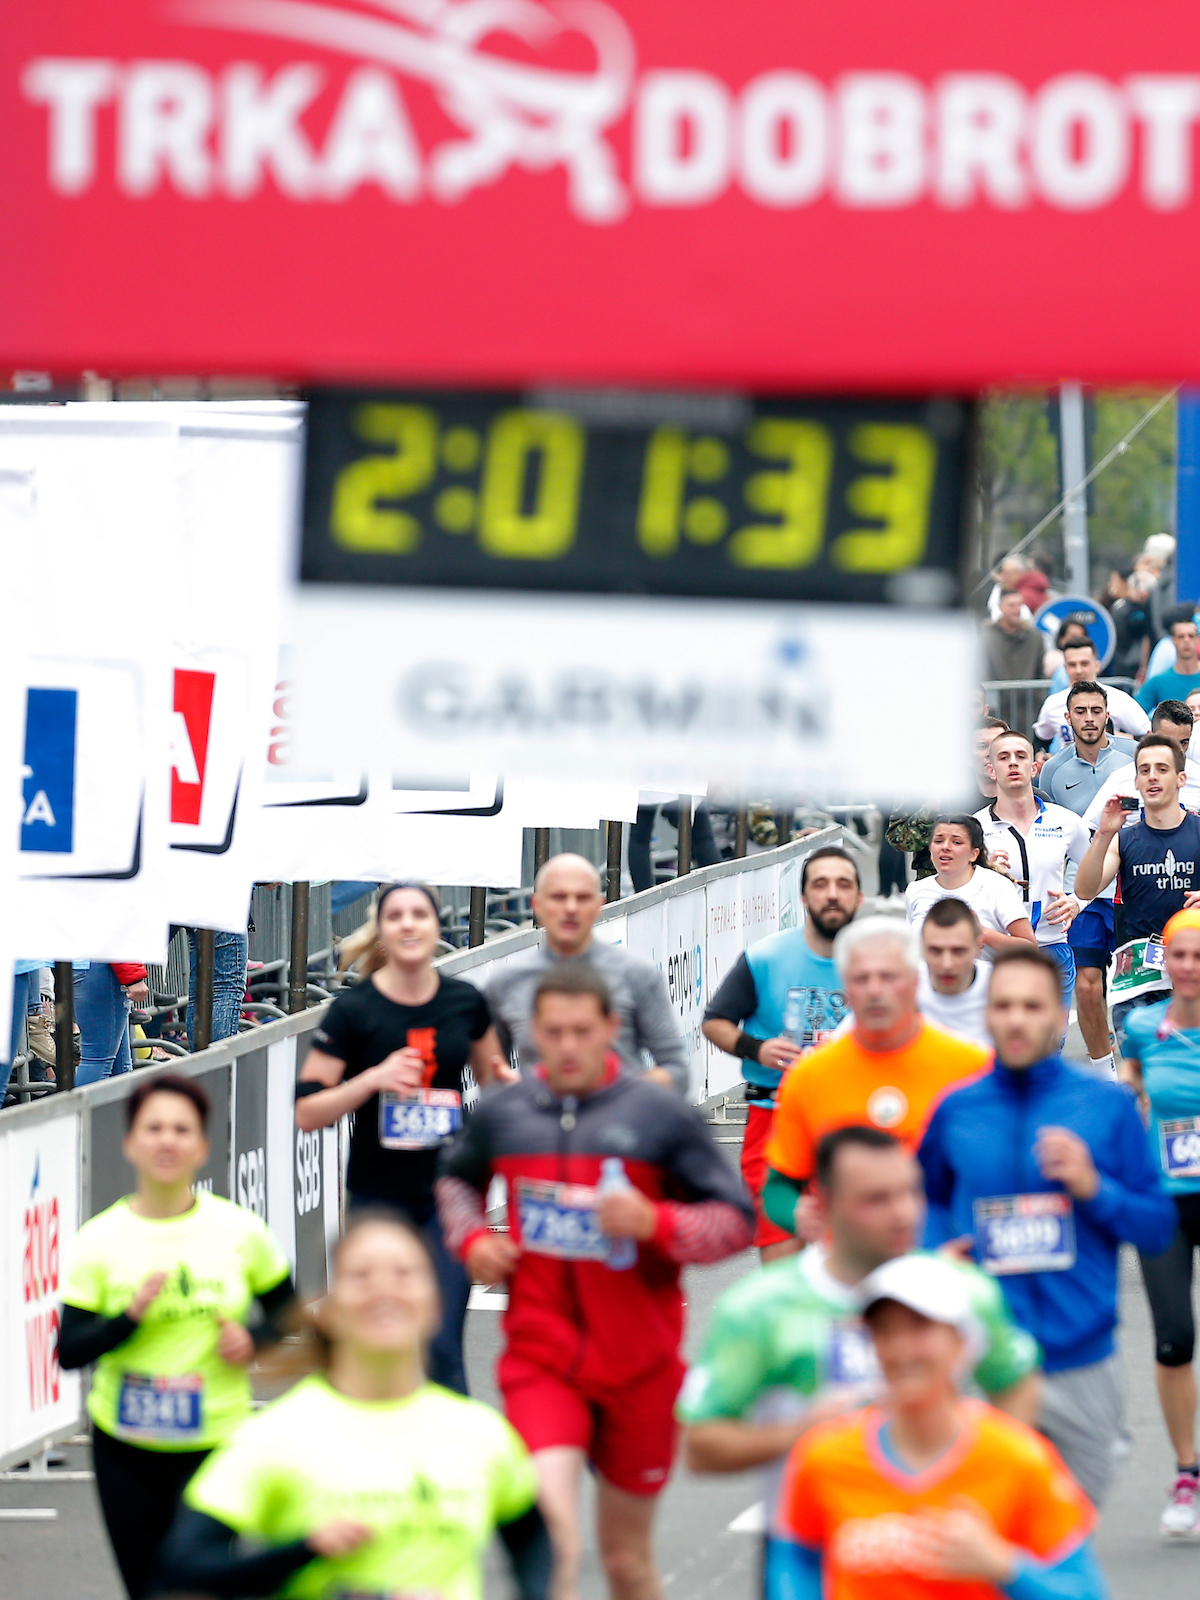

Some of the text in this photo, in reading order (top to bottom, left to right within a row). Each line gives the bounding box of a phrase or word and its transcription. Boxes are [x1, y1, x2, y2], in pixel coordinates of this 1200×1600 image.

[22, 57, 422, 200] TRKA
[331, 402, 937, 574] 2:01:33
[395, 658, 842, 746] GARMIN
[1156, 876, 1192, 890] tribe
[296, 1127, 322, 1217] SBB
